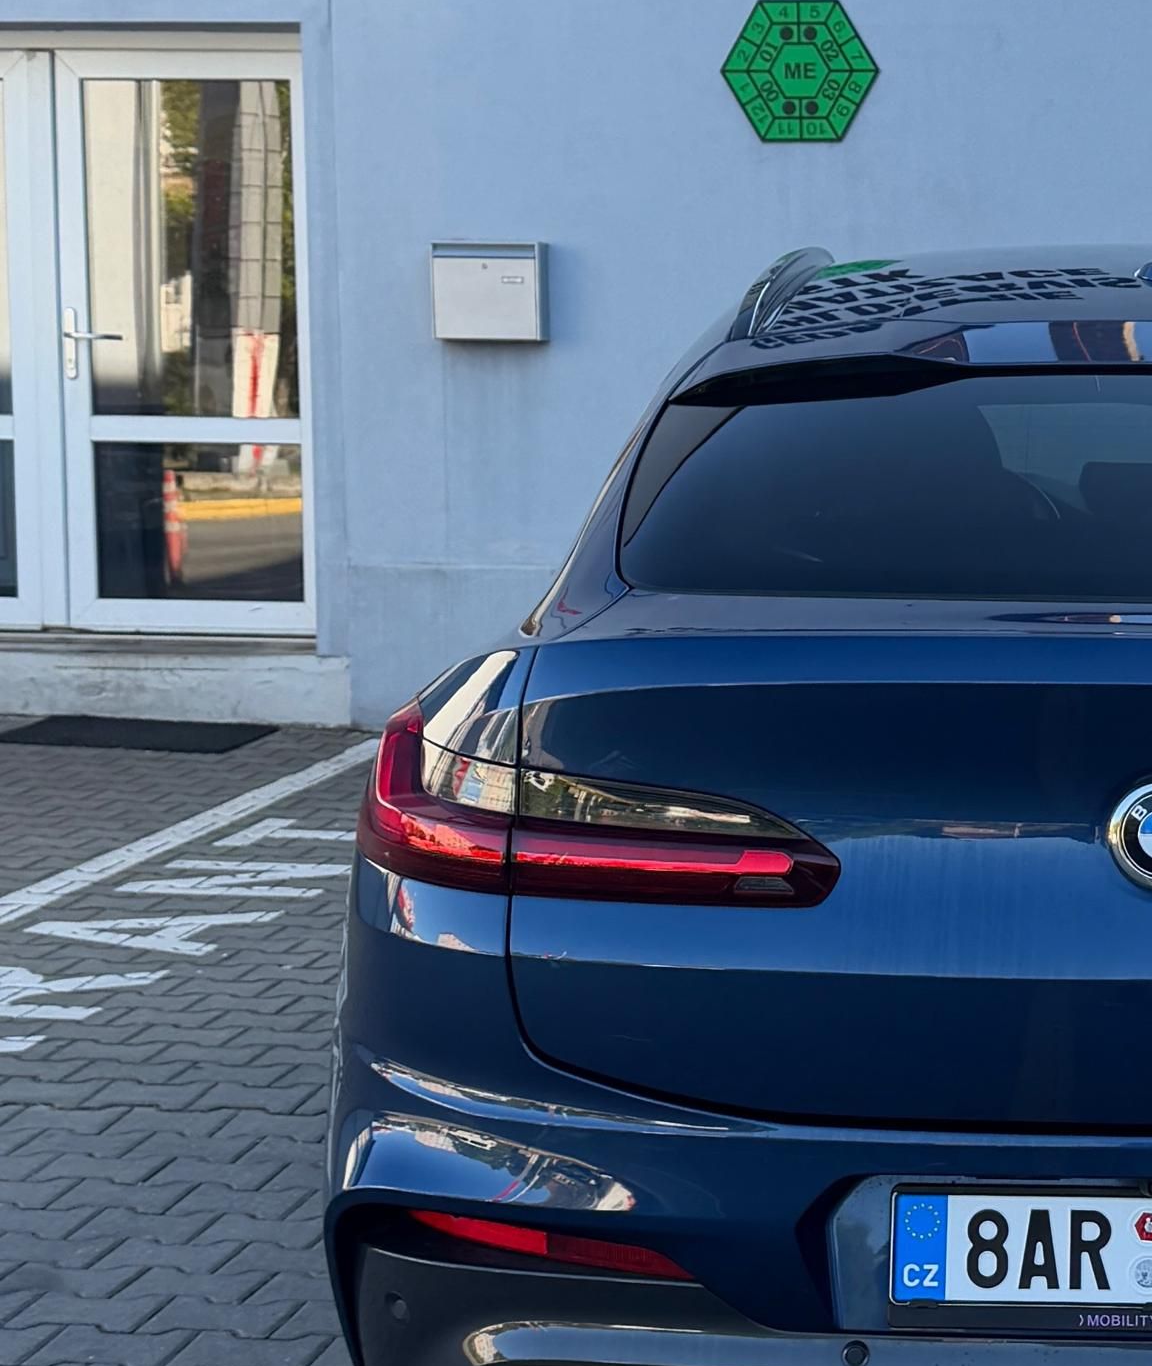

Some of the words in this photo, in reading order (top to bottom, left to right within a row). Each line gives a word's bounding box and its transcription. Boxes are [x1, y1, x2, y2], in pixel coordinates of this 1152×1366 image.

[778, 6, 789, 18] 4
[809, 6, 820, 18] 5
[821, 39, 839, 62] 02
[784, 63, 816, 79] ME
[821, 79, 840, 100] 03
[966, 1208, 1112, 1290] 8AR
[903, 1263, 939, 1287] CZ
